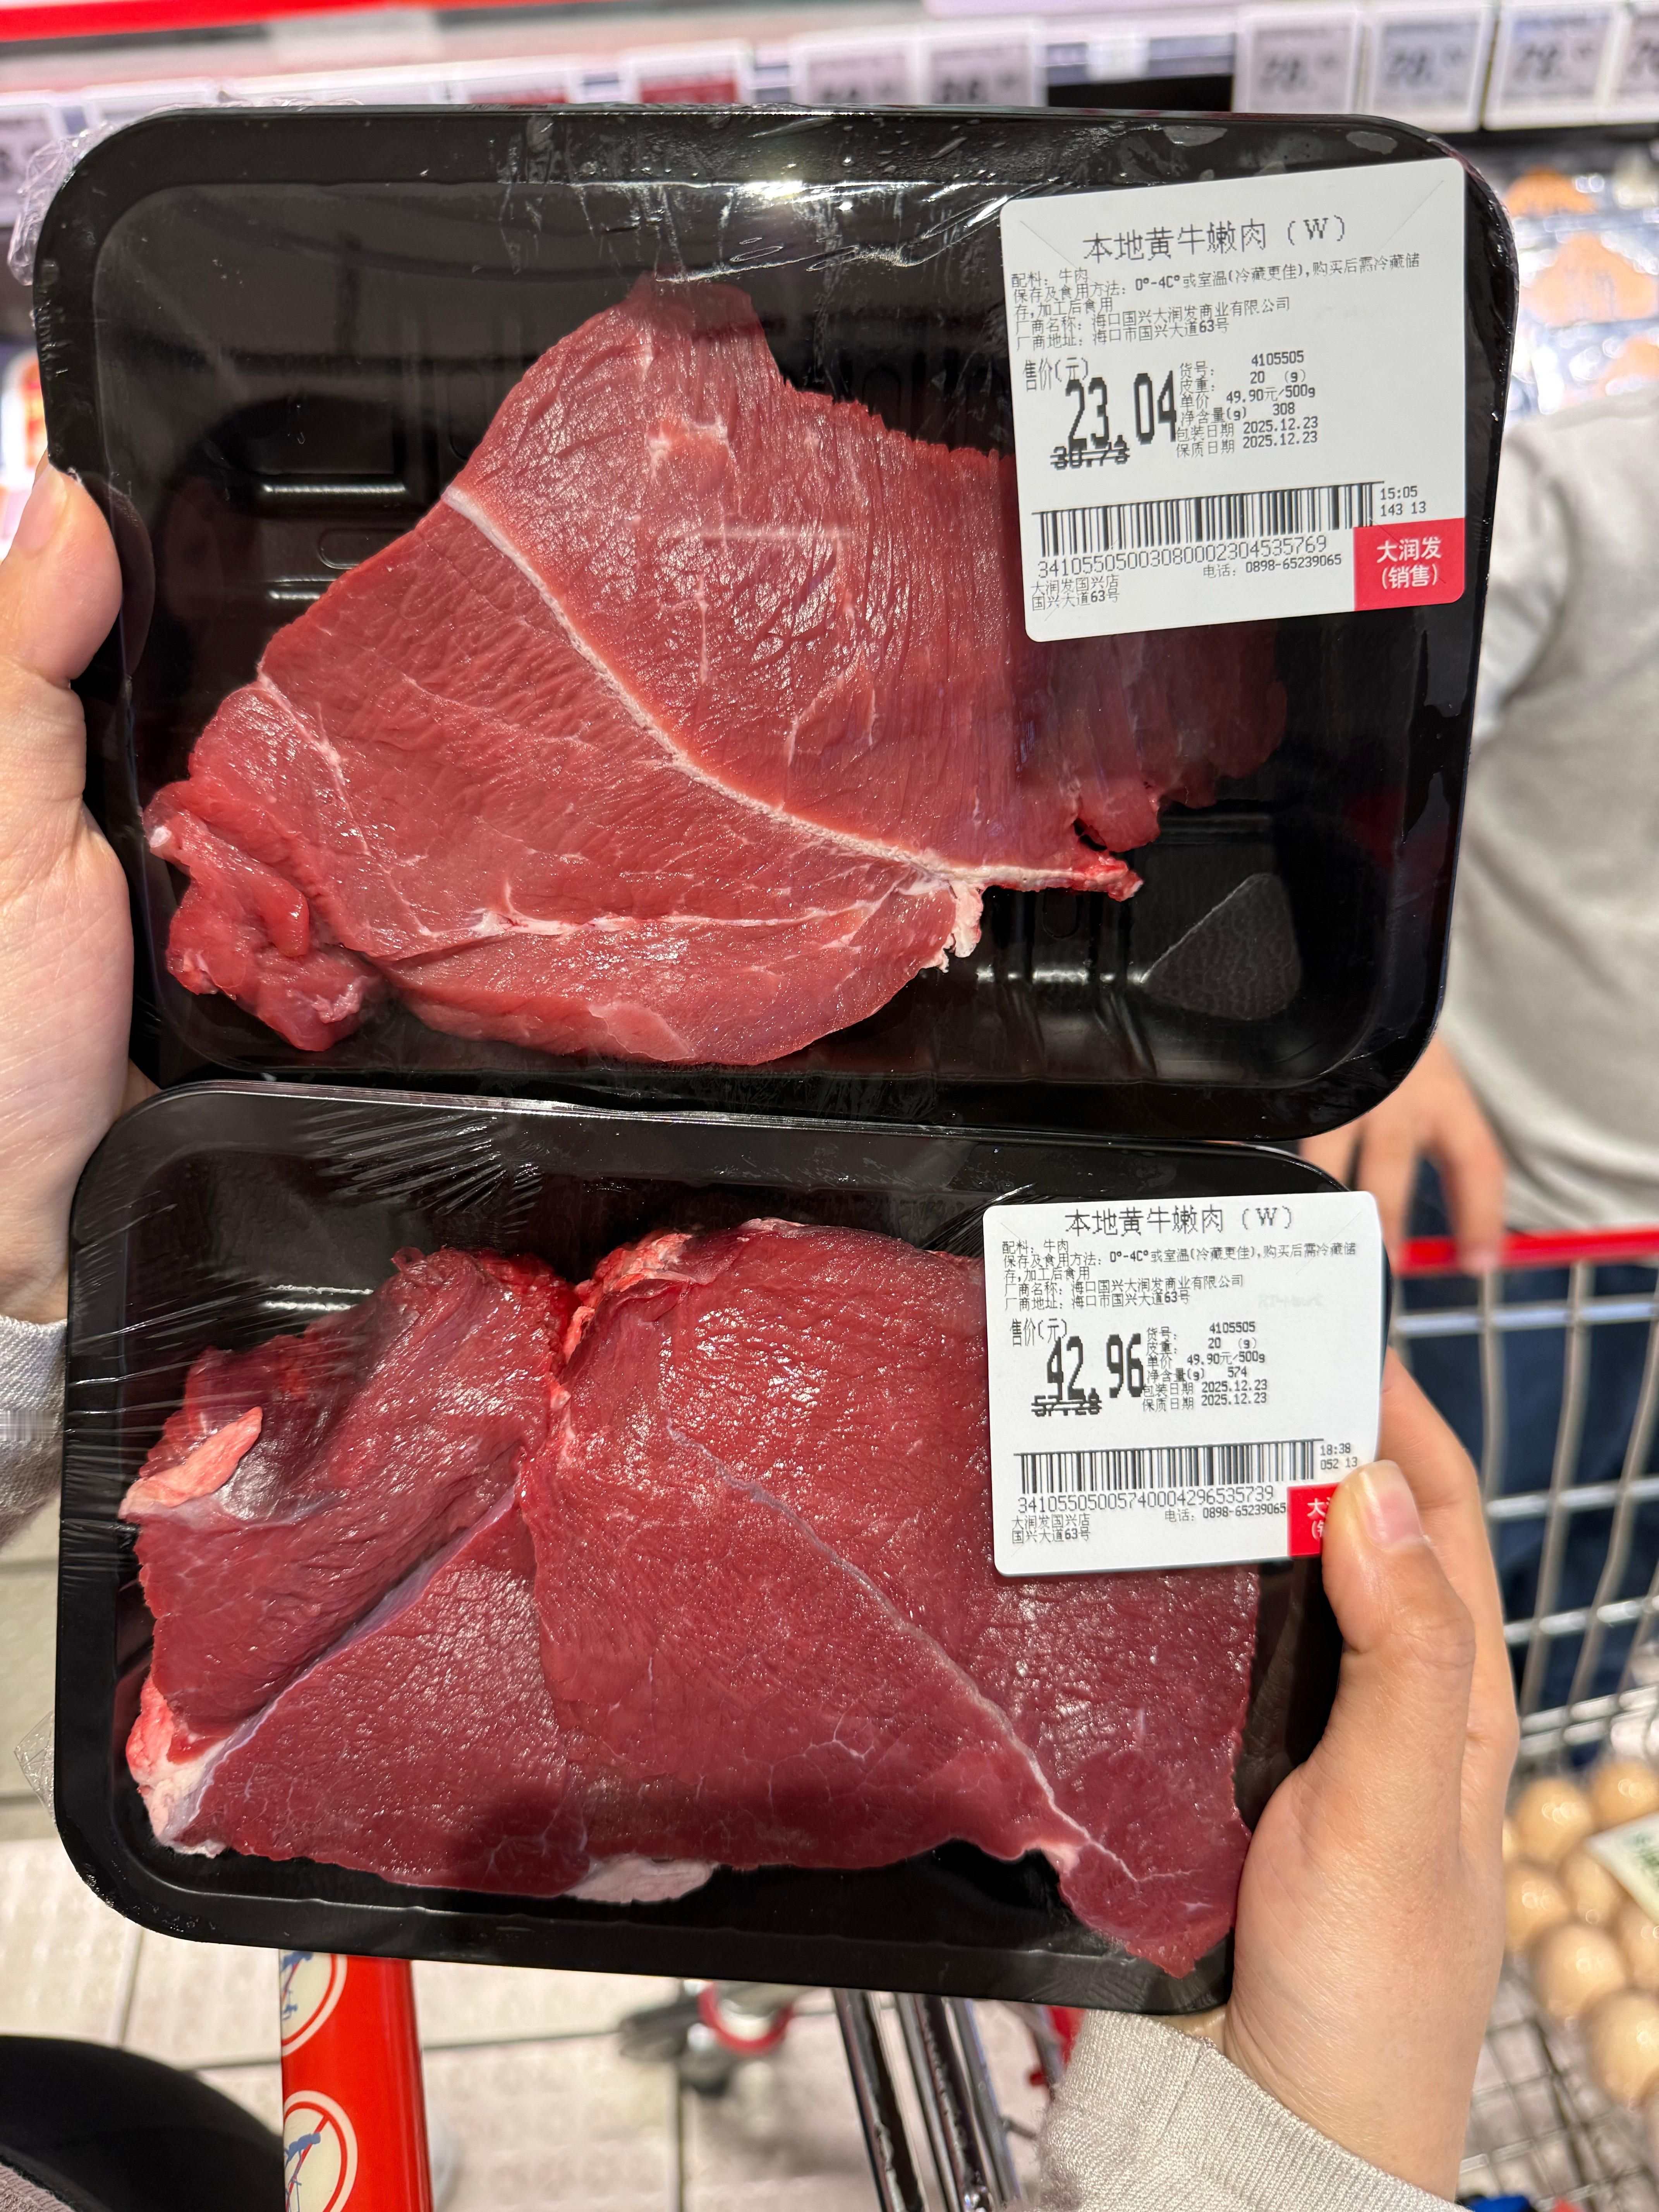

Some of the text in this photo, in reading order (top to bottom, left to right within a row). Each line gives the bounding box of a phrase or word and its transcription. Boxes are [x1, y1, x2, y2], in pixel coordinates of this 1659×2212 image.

[1251, 350, 1304, 367] 4105505
[1023, 357, 1088, 392] 售价(元)
[1250, 371, 1265, 384] 20
[1180, 384, 1316, 412] 单价 49.90元/500g
[1065, 370, 1177, 449] 23.04
[1273, 402, 1295, 416] 308
[1176, 416, 1318, 443] 包装日期 2025.12.23
[1176, 431, 1318, 459] 保质日期 2025.12.23
[1380, 486, 1418, 501] 15:05
[1380, 501, 1426, 517] 143 13
[1038, 535, 1327, 579] 34105505003080002304535769
[1376, 537, 1442, 563] 大润发
[1030, 574, 1120, 596] 大润发国兴店
[1382, 564, 1437, 590] (销售)
[1032, 589, 1120, 612] 国兴大道63号
[1010, 1317, 1067, 1346] 售价(元)
[1209, 1321, 1255, 1334] 4105505
[1208, 1337, 1221, 1349] 20
[1046, 1333, 1144, 1400] 42.96
[1147, 1351, 1265, 1369] 单价 49.90元/500g
[1227, 1366, 1247, 1378] 574
[1142, 1379, 1267, 1398] 包装日期 2025.12.23
[1142, 1392, 1267, 1412] 保质日期 2025.12.23
[1320, 1443, 1351, 1456] 18:38
[1320, 1457, 1357, 1470] 052 13
[1018, 1486, 1274, 1513] 34105505005740004296535739
[1012, 1513, 1091, 1530] 大润发国兴店
[1012, 1527, 1091, 1544] 国兴大道63号
